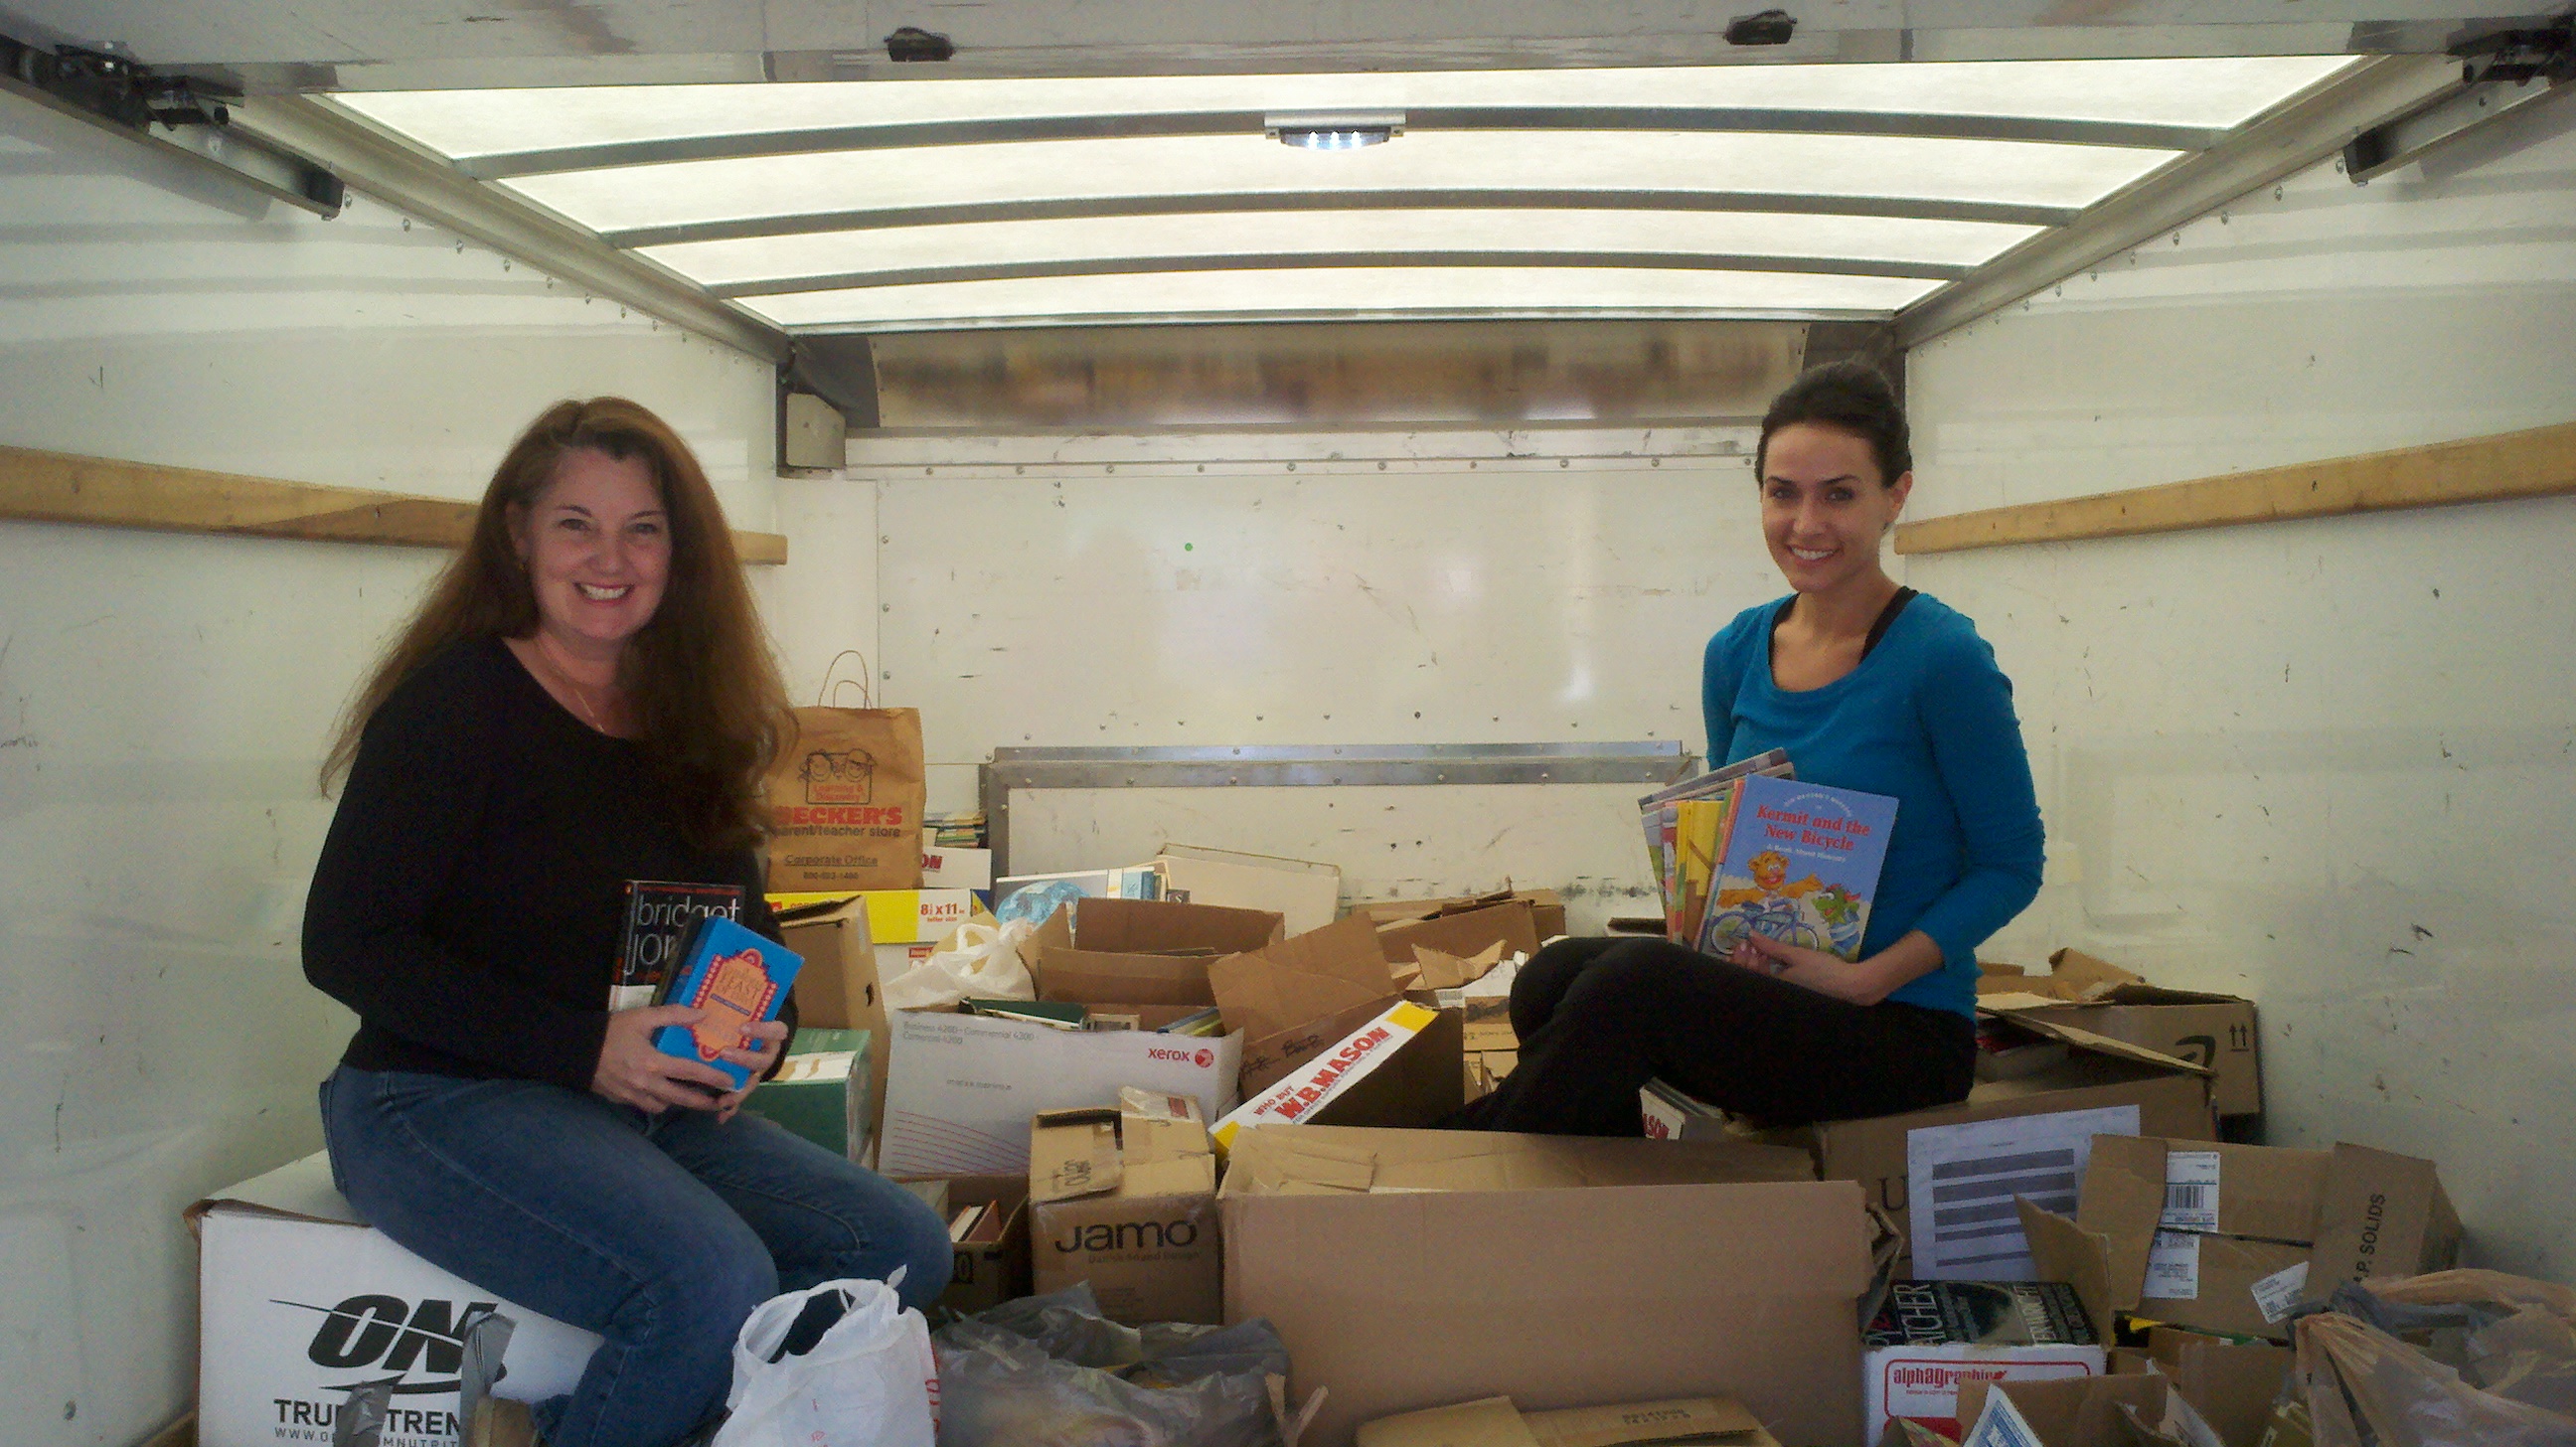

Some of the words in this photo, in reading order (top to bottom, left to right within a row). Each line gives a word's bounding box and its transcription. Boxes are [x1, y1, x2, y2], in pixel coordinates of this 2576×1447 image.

[870, 826, 901, 838] store
[1756, 803, 1810, 826] Kermit
[1812, 816, 1844, 832] and
[1845, 819, 1871, 837] the
[1764, 823, 1797, 841] New
[1800, 829, 1855, 851] Bicycle
[784, 855, 843, 867] Corporate
[845, 855, 878, 866] Office
[1148, 1046, 1191, 1062] xerox
[1054, 1218, 1199, 1253] Jamo
[2359, 1193, 2386, 1255] SOLIDS
[1893, 1283, 1947, 1346] ATCHER
[307, 1294, 499, 1374] ON
[386, 1408, 461, 1436] TREN
